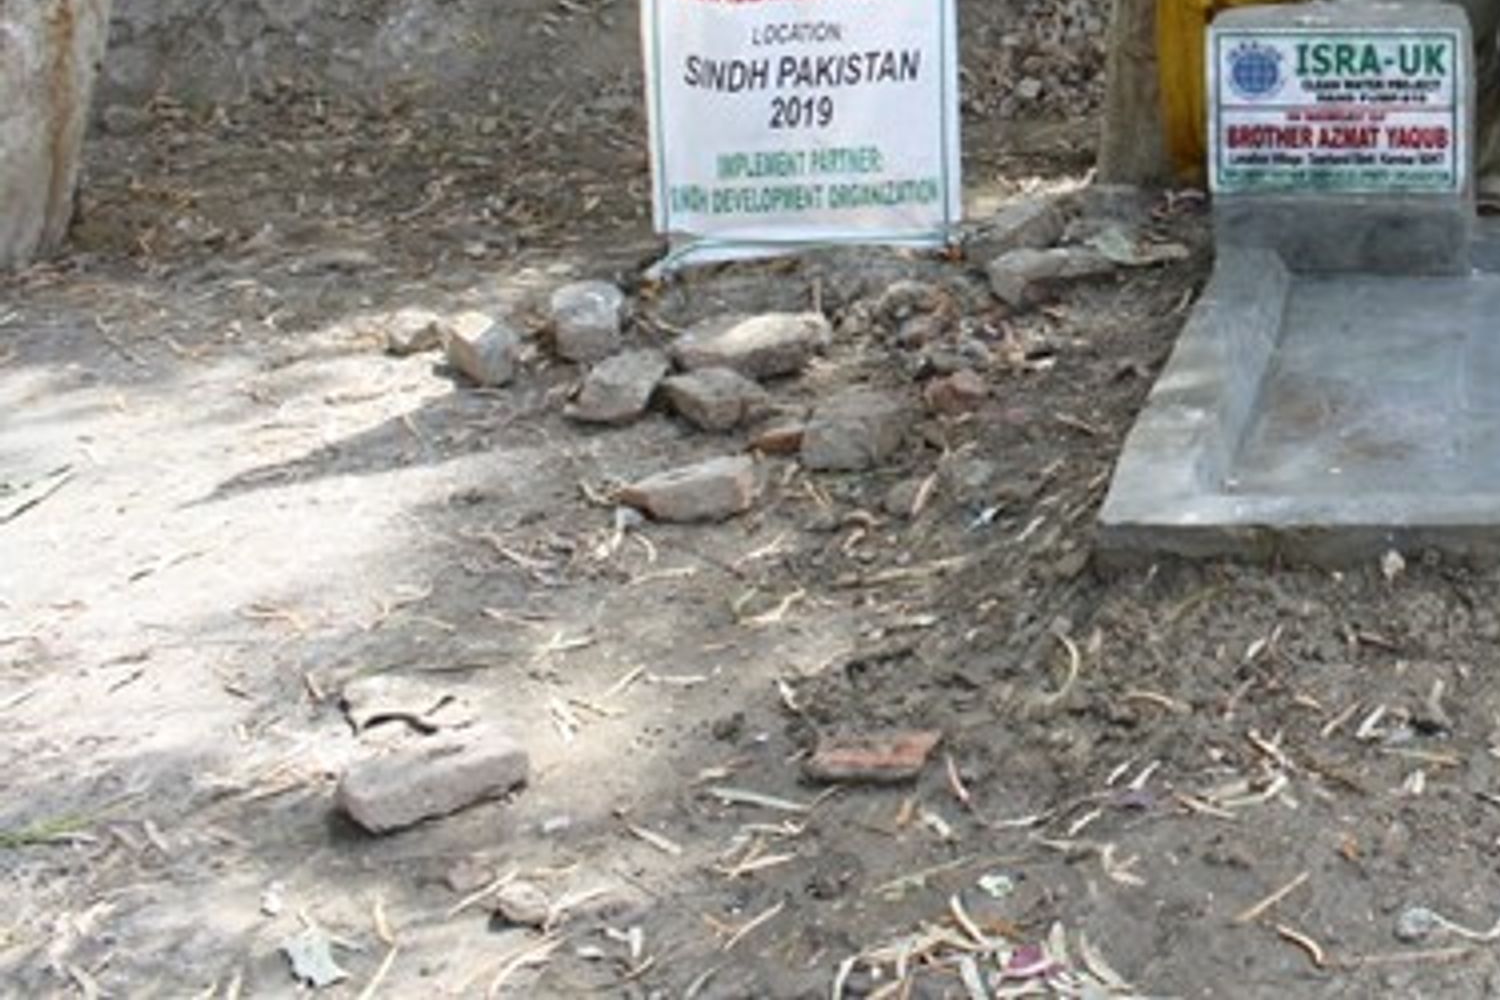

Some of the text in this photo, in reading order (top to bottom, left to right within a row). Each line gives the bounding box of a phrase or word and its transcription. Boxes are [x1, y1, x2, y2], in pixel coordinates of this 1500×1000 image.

[752, 21, 842, 46] LOCATION
[683, 49, 921, 93] SINDH PAKISTAN
[1296, 43, 1445, 76] ISRA-UK
[768, 96, 833, 129] 2019
[1227, 124, 1449, 149] BROTHER AZMAT YAQUB
[717, 151, 805, 179] IMPLEMENT
[712, 183, 822, 213] DEVELOPMENT
[828, 177, 938, 209] ORGANIZATION
